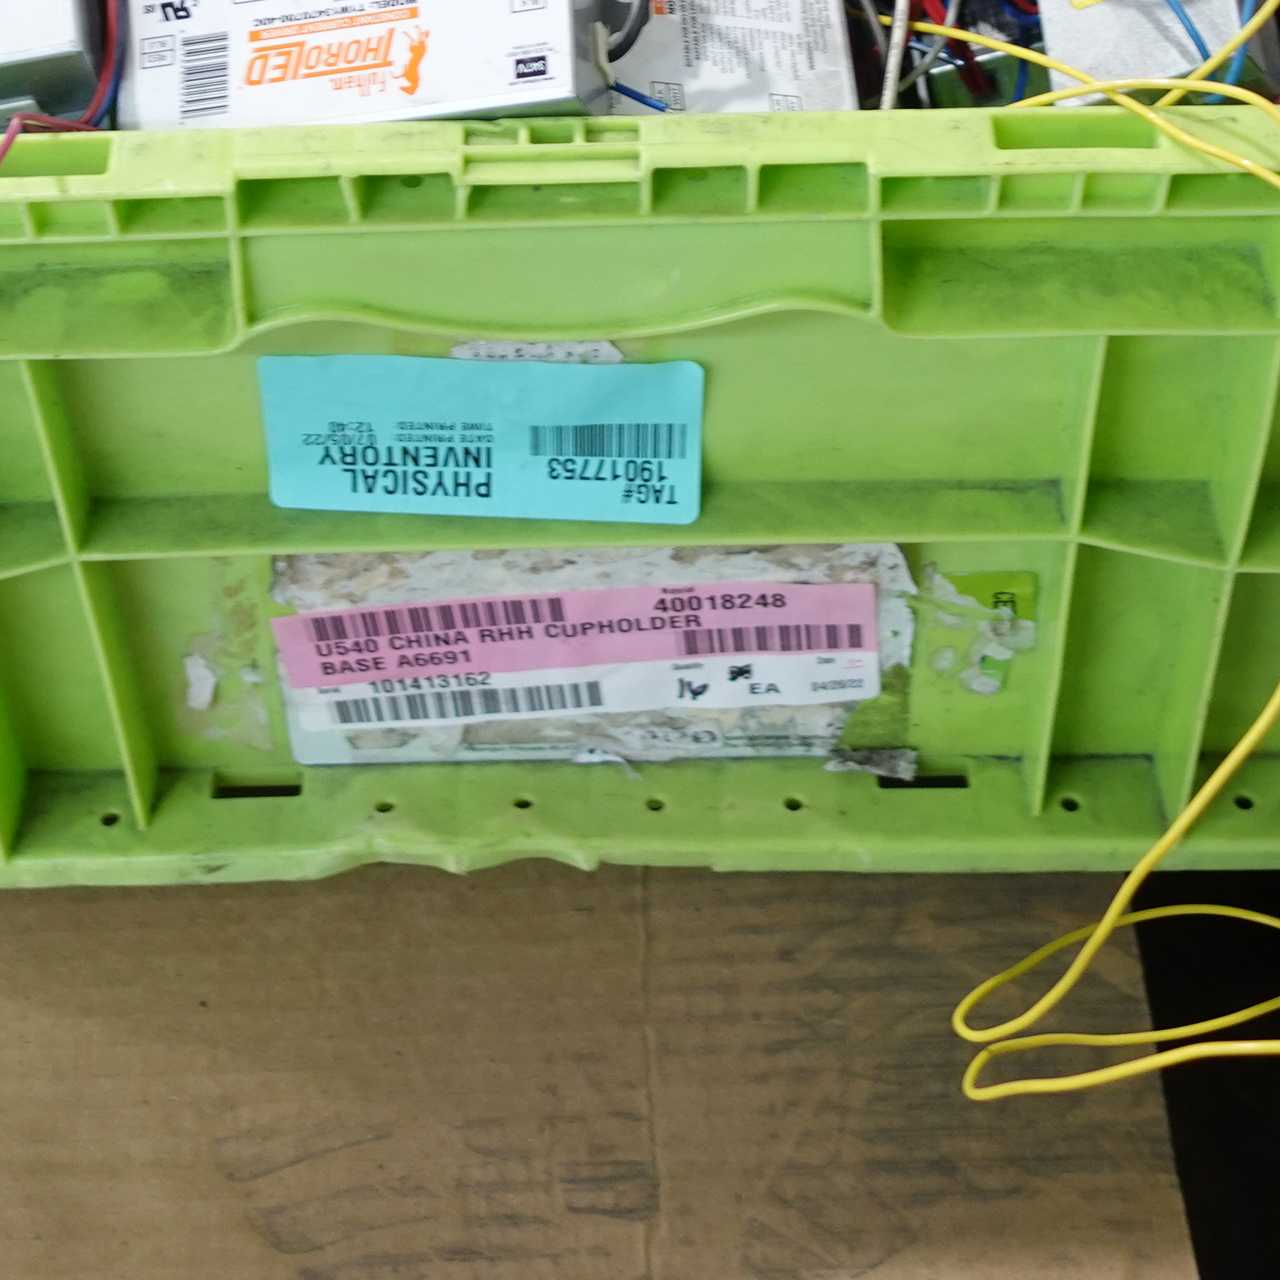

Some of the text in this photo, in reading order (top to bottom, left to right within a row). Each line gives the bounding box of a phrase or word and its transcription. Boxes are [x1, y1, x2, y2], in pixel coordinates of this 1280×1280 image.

[459, 433, 495, 444] DATE
[461, 422, 494, 432] TIME
[318, 444, 493, 468] INVENTORY
[548, 457, 669, 483] 19017753
[346, 468, 493, 499] PHYSICAL
[621, 484, 680, 505] TAG#
[653, 593, 787, 615] 40018248
[315, 614, 702, 657] U540 CHINA RHH CUPHOLDER
[321, 650, 472, 675] BASE A6691
[369, 671, 491, 694] 101413162
[749, 681, 781, 696] EA
